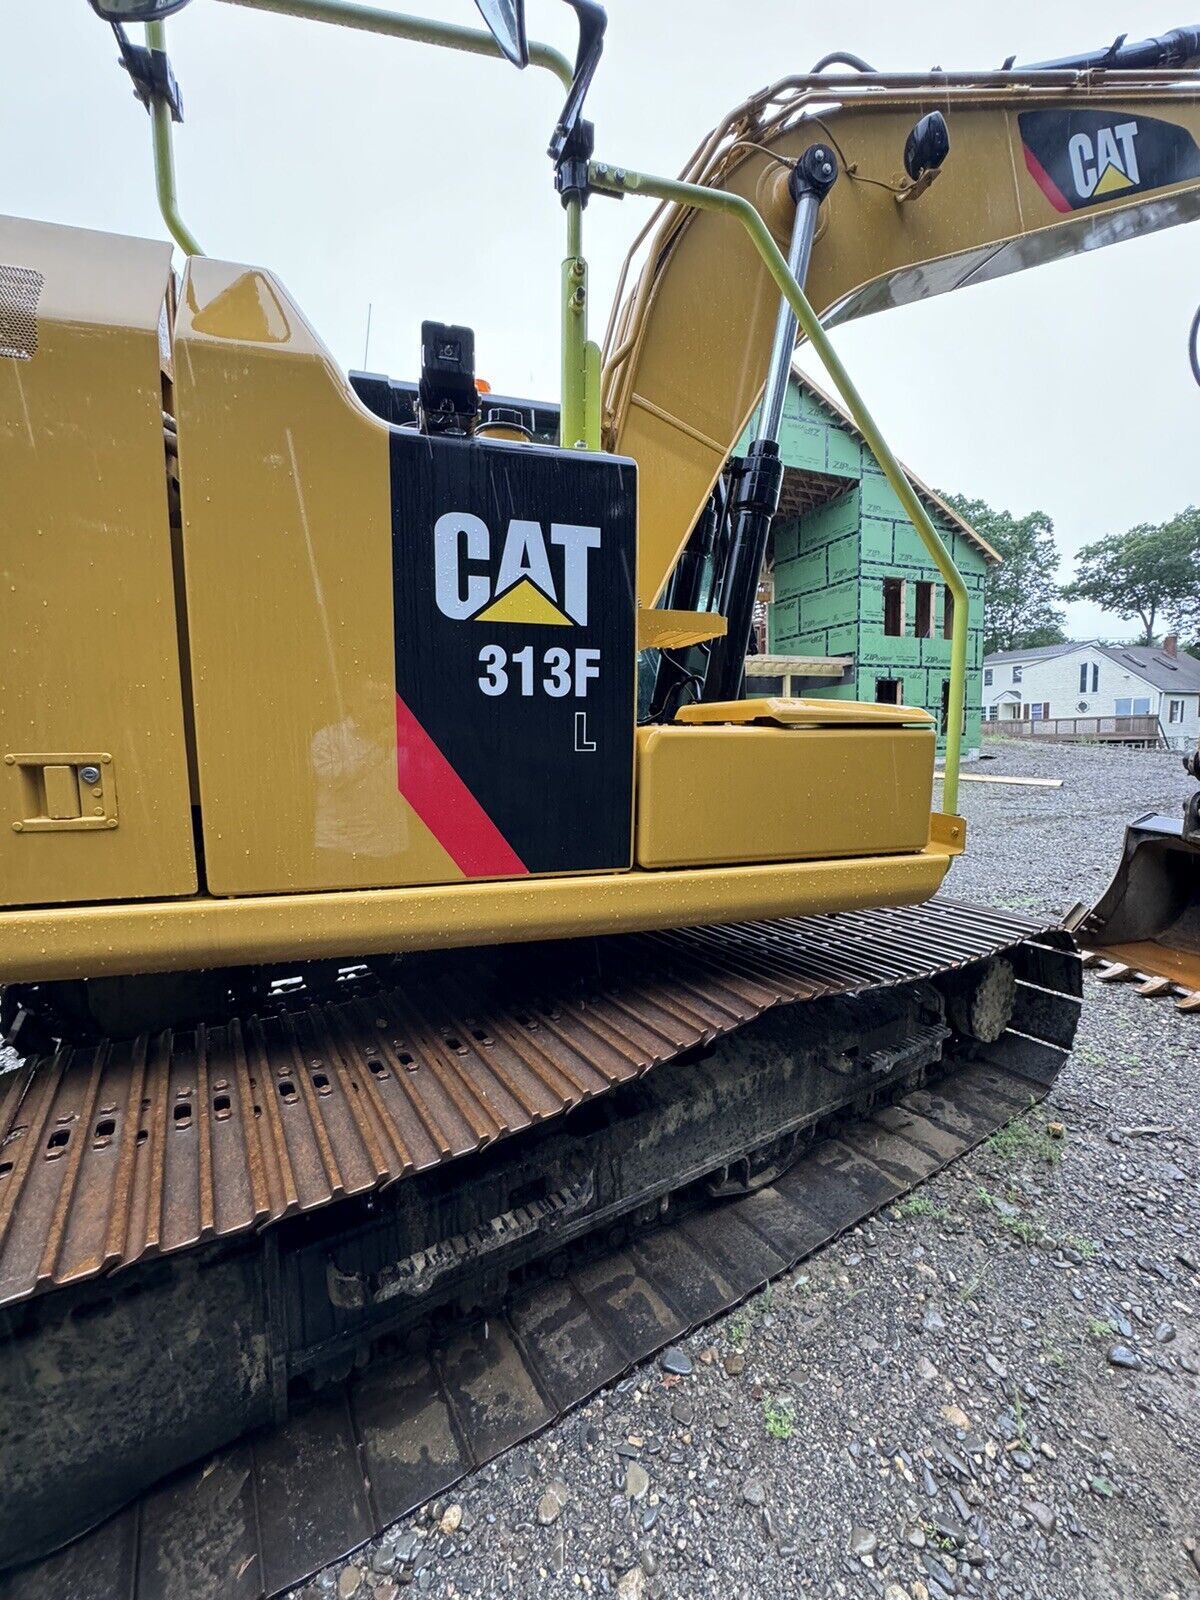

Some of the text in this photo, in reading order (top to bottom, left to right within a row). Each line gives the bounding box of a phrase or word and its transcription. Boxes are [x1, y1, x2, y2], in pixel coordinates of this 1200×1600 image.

[1068, 121, 1140, 199] CAT
[433, 511, 602, 627] CAT
[477, 644, 601, 698] 313F
[863, 653, 879, 661] ZIP
[924, 655, 939, 664] ZIP
[573, 711, 597, 753] L
